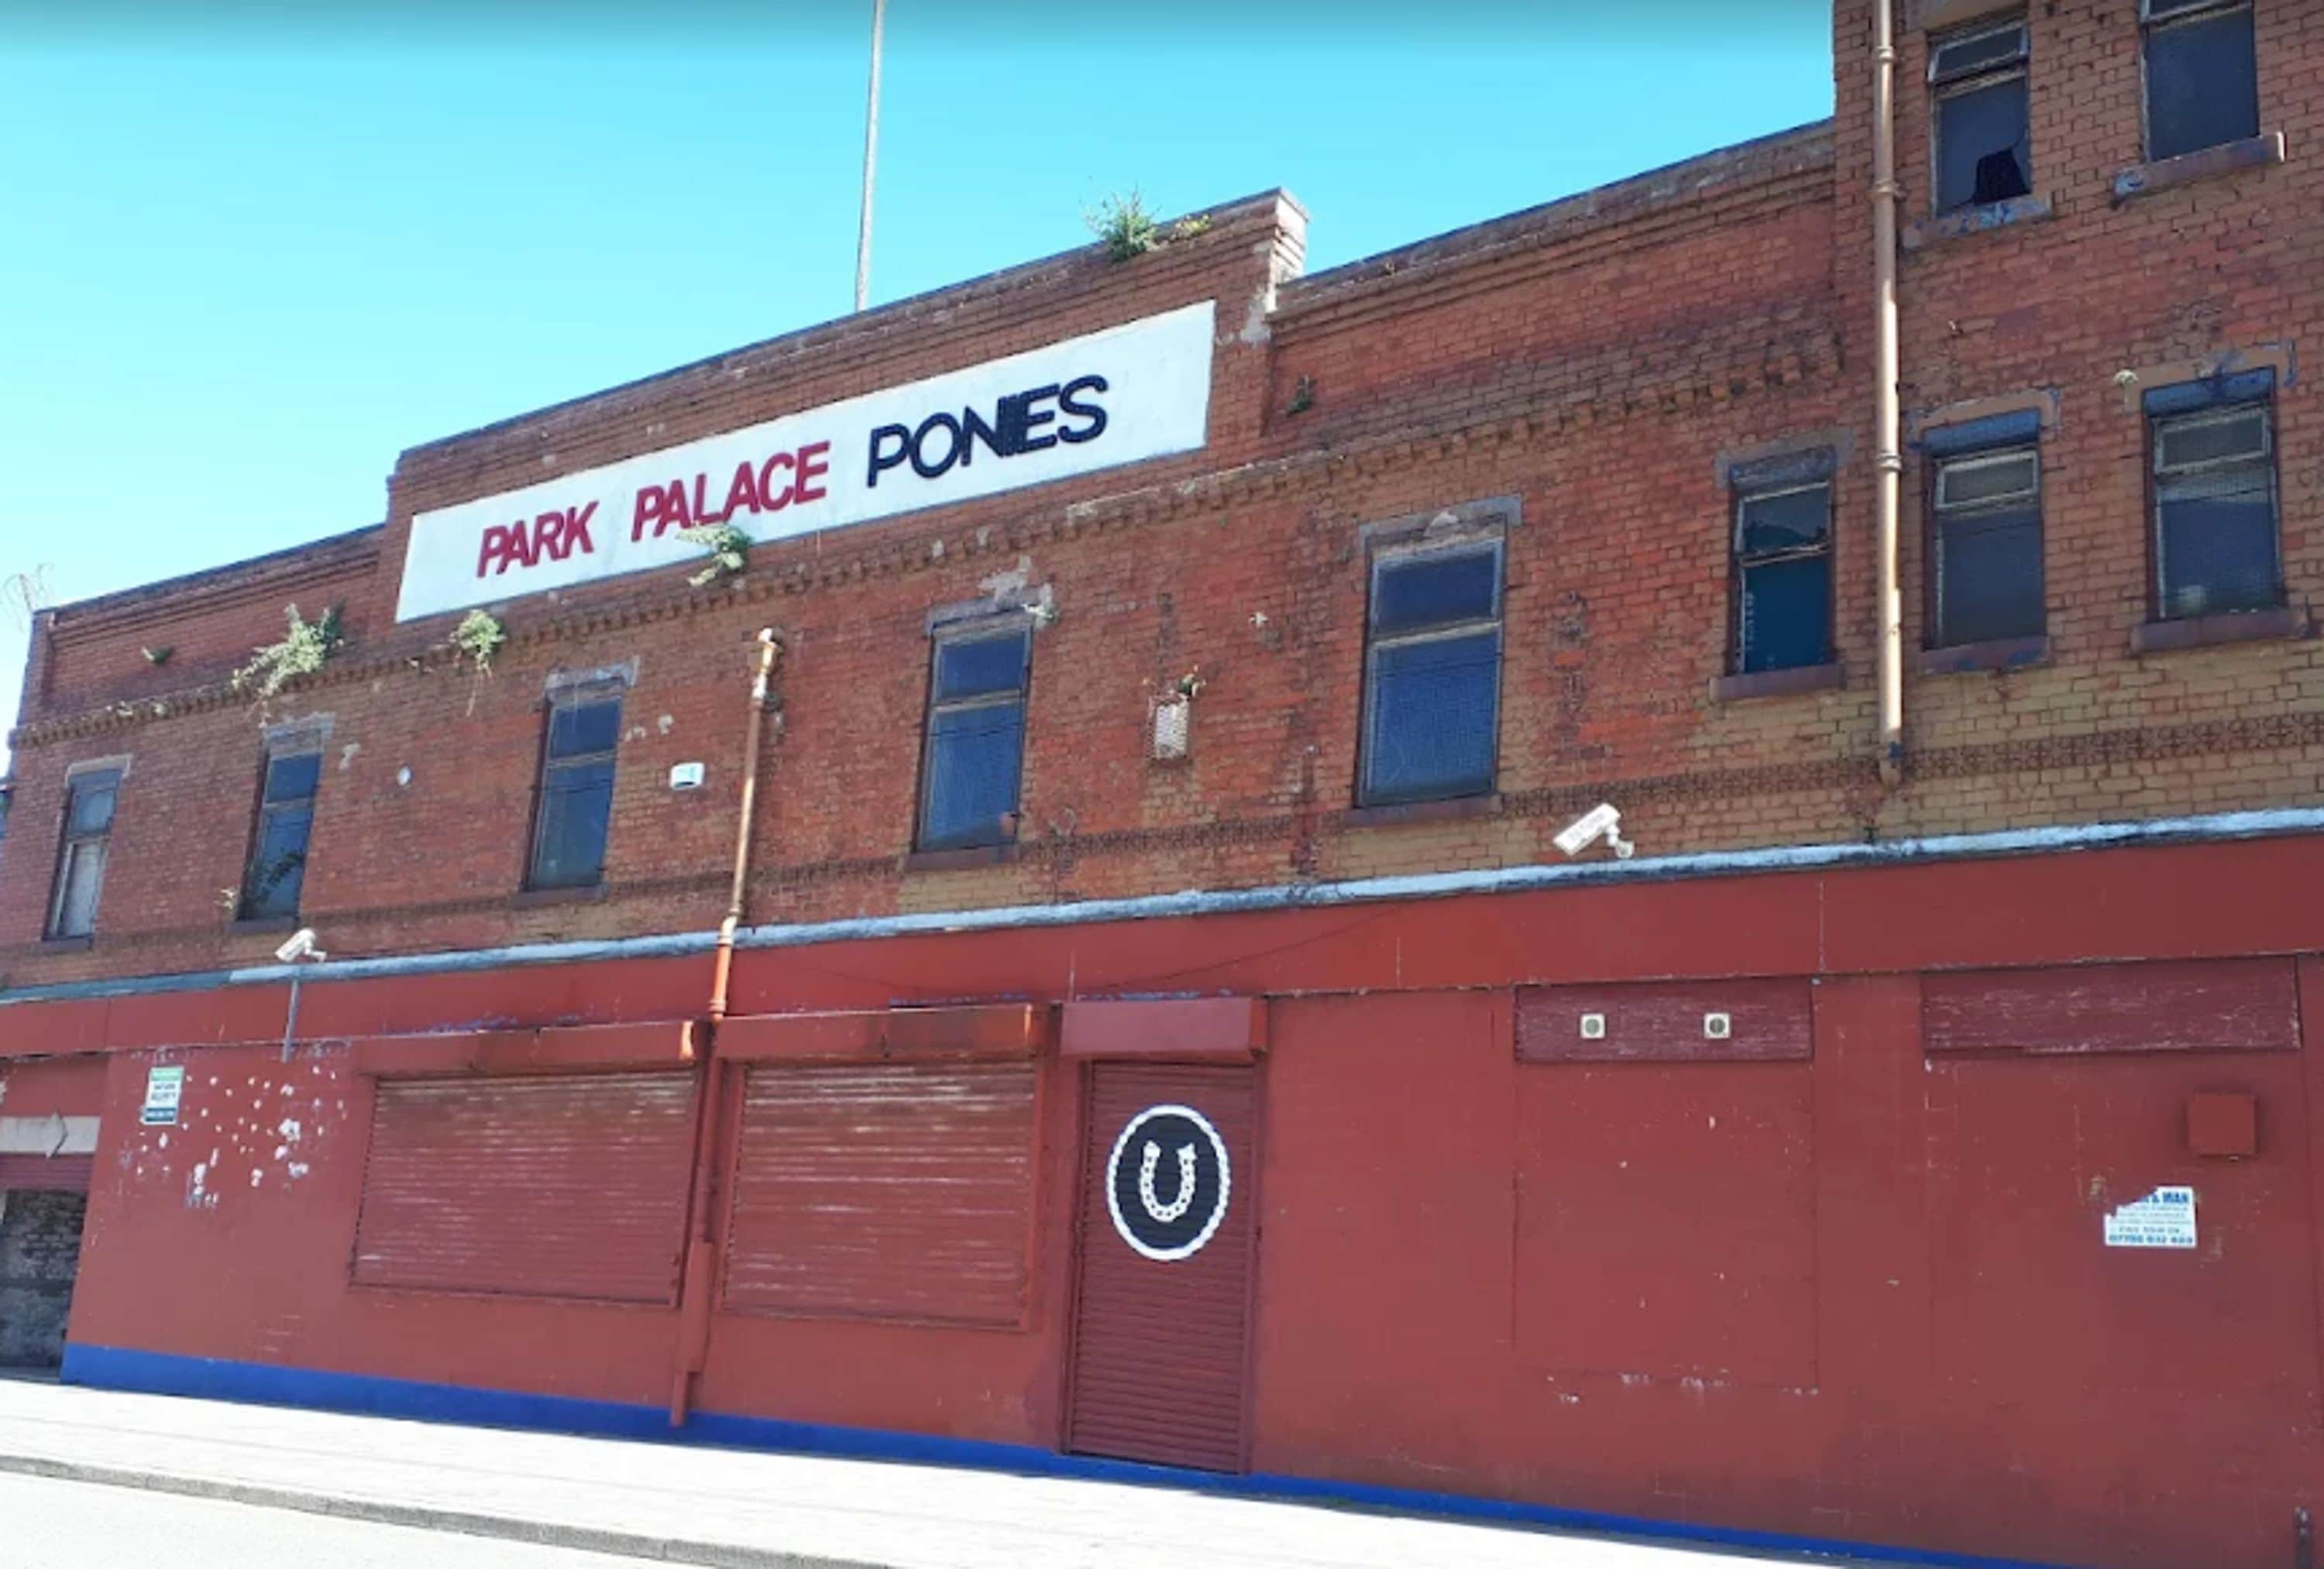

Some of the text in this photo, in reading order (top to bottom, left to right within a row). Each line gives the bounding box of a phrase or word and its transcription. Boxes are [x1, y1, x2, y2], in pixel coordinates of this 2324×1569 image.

[476, 374, 1109, 579] PARK PALACE PONIES
